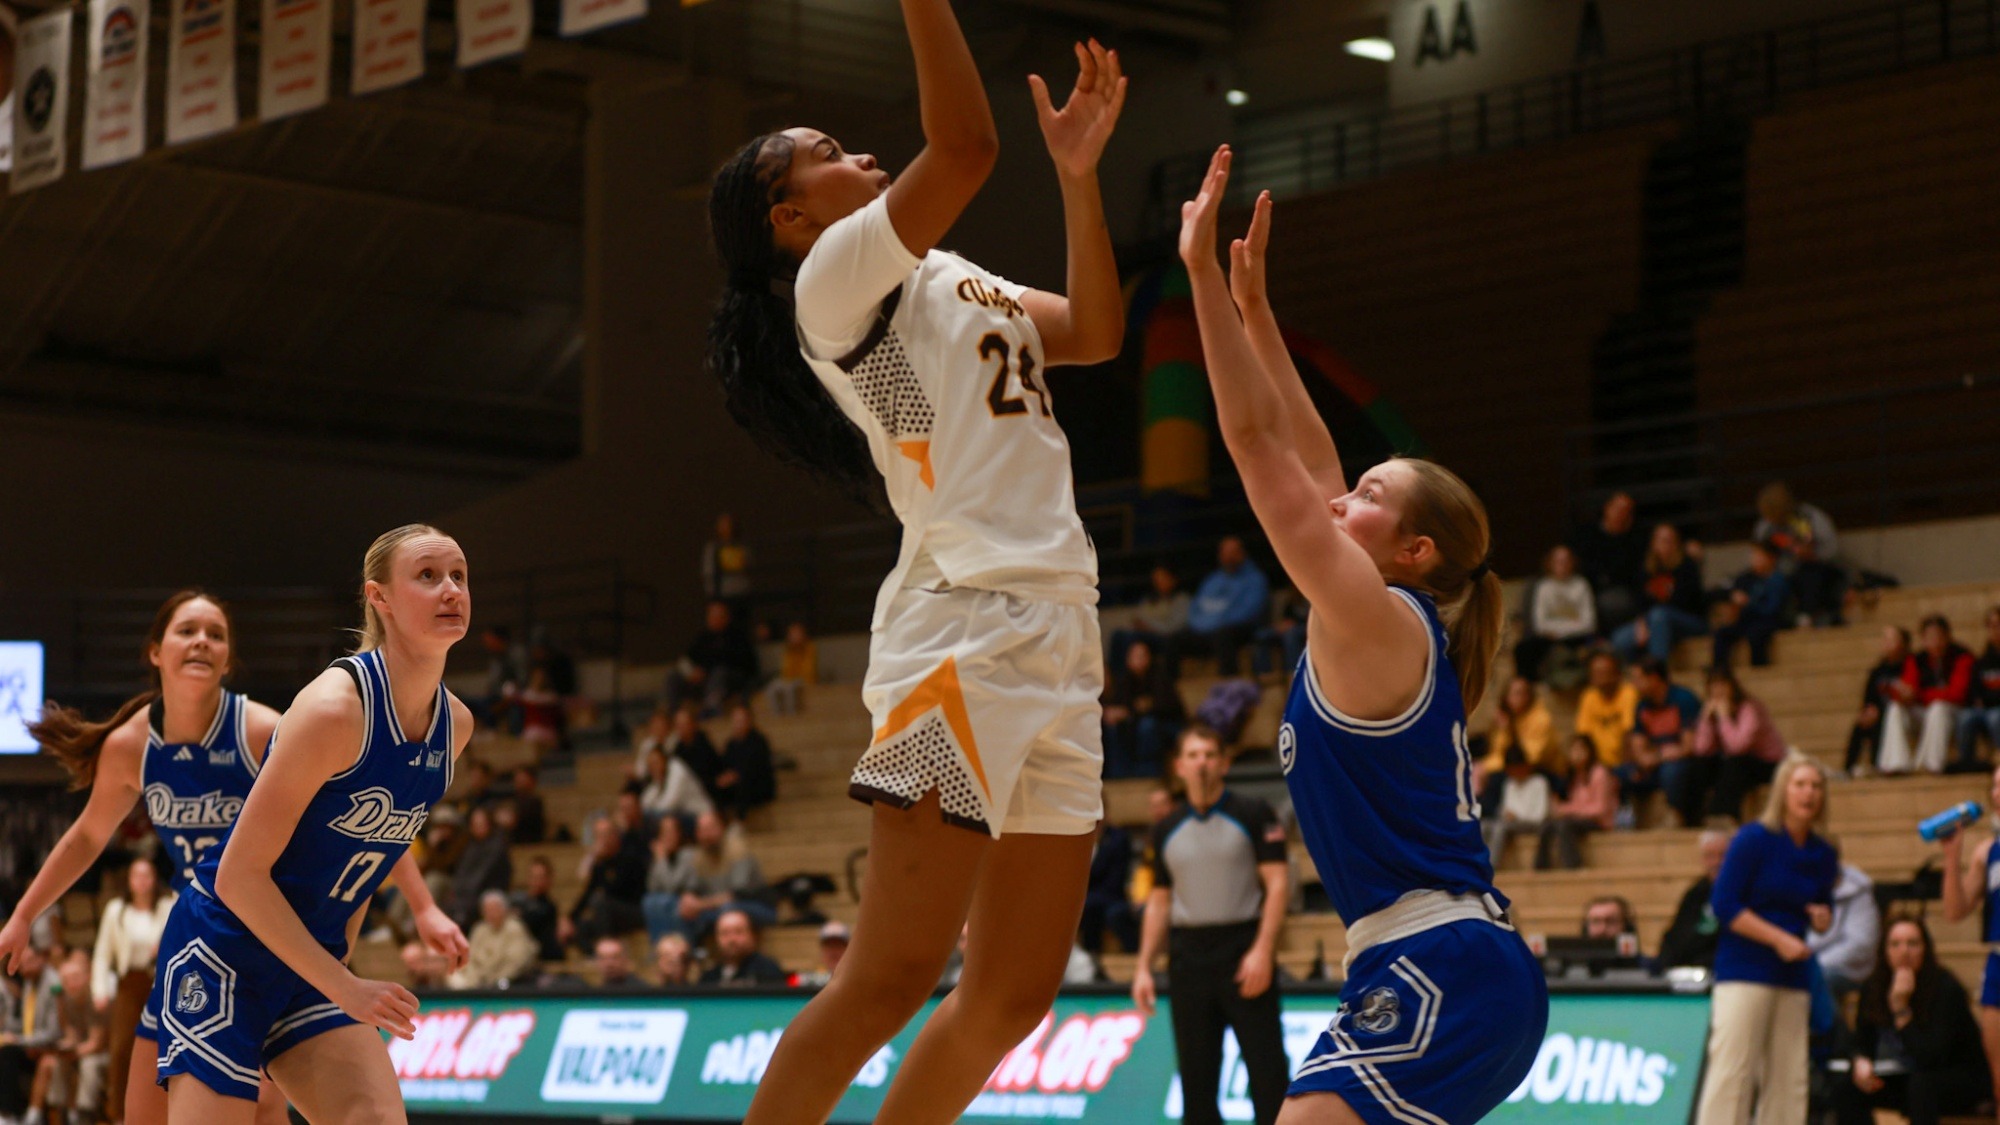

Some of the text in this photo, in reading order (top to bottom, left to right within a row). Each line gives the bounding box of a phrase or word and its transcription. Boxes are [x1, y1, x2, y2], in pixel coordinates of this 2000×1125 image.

[1414, 1, 1478, 68] AA
[144, 782, 244, 829] Drake
[328, 851, 387, 903] 17
[453, 1008, 536, 1080] OFF
[701, 1027, 784, 1084] PAP
[1035, 1011, 1146, 1093] OFF
[1505, 1032, 1669, 1106] OHNS
